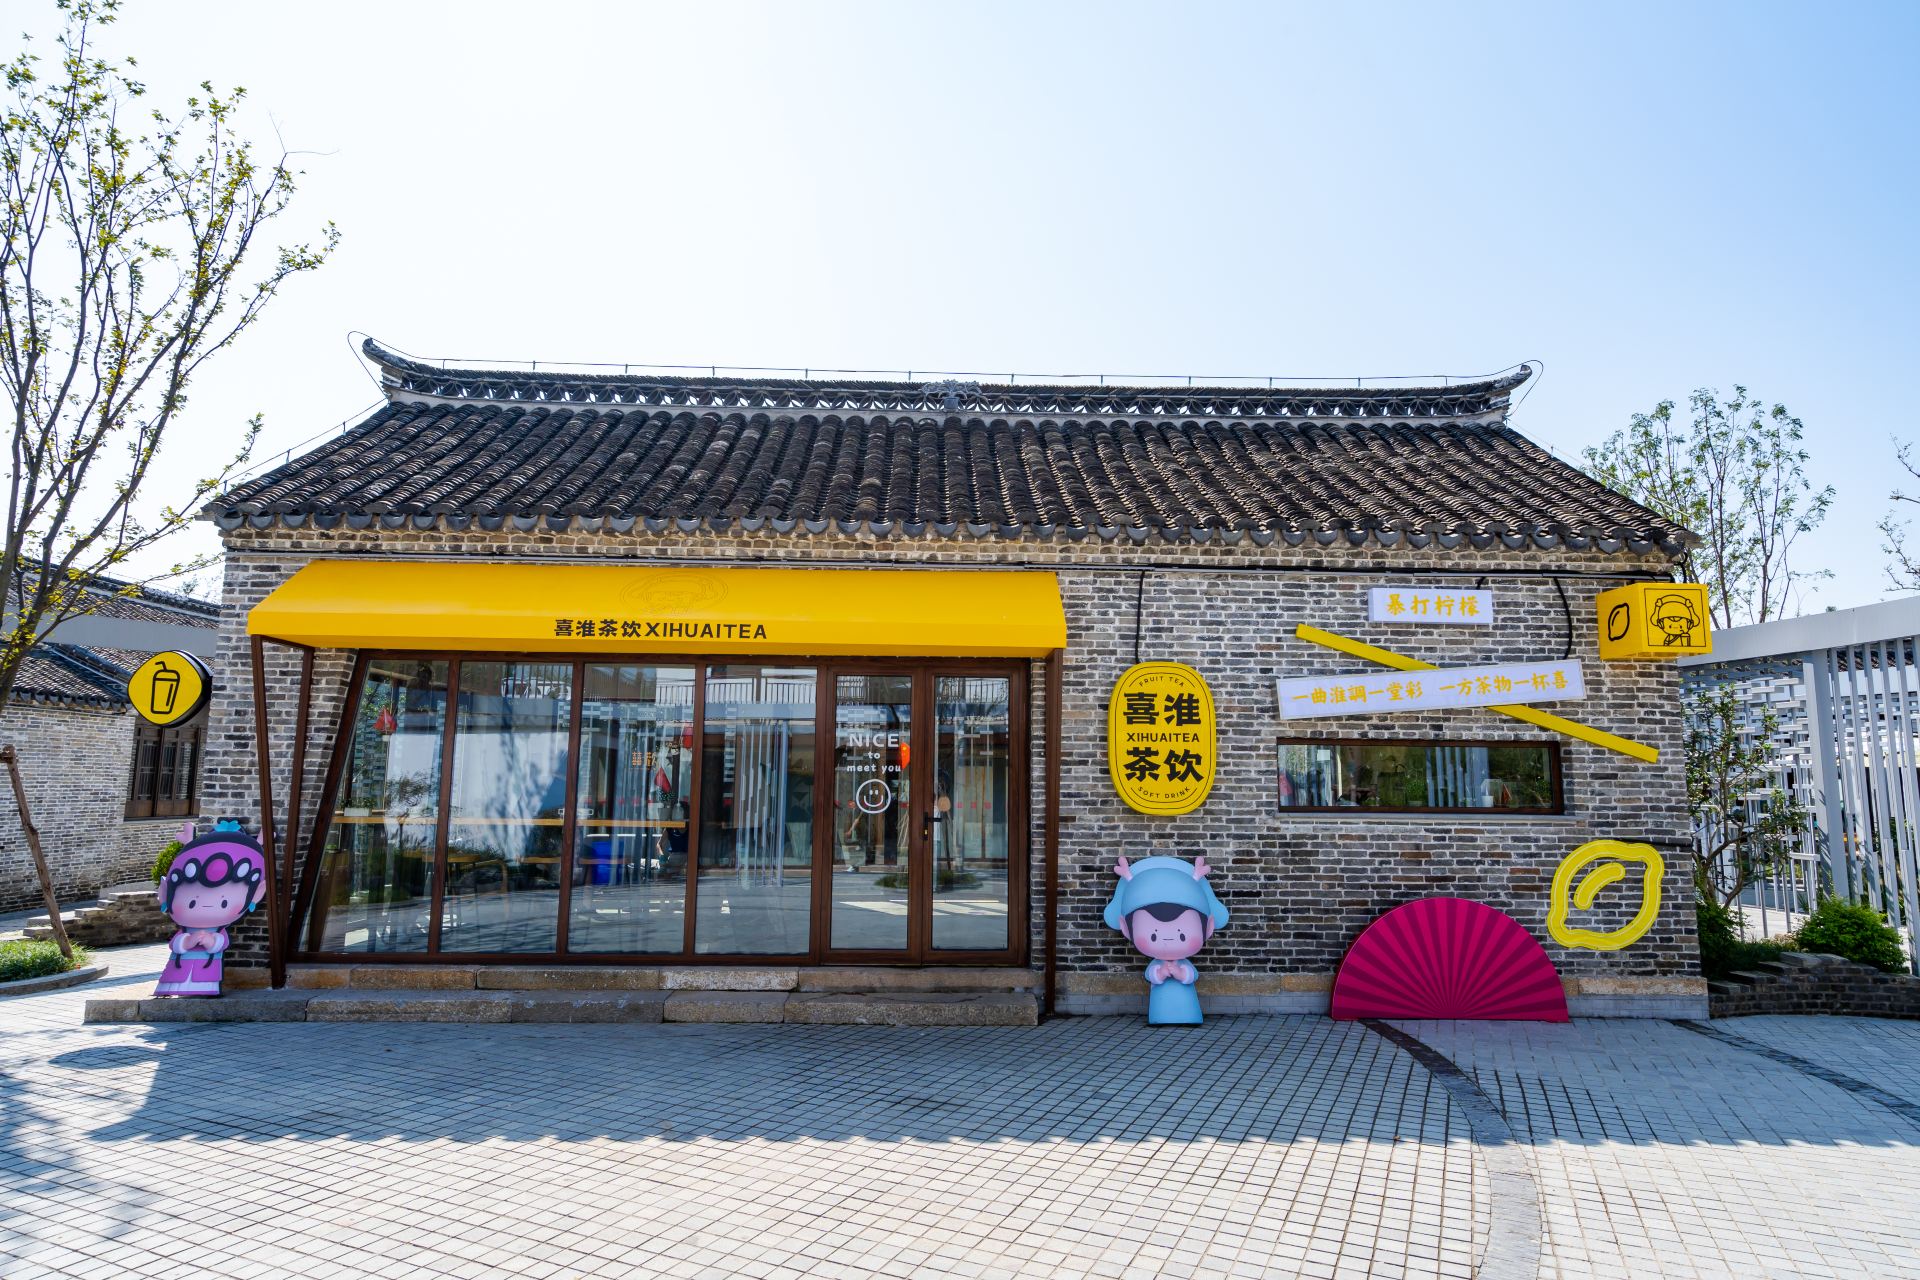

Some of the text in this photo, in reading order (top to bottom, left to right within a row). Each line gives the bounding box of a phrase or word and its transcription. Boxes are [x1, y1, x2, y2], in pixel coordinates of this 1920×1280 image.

[1386, 593, 1480, 616] 暴打柠檬
[1139, 676, 1184, 687] FRUIT TEA
[1439, 670, 1569, 696] 一方茶物一杯喜
[1123, 692, 1202, 726] 喜淮
[849, 733, 899, 748] NICE
[1126, 732, 1200, 743] XIHUAITEA
[867, 751, 881, 759] to
[847, 764, 901, 774] meet you
[1123, 747, 1204, 783] 茶饮
[1137, 786, 1191, 799] SOFT DRINK
